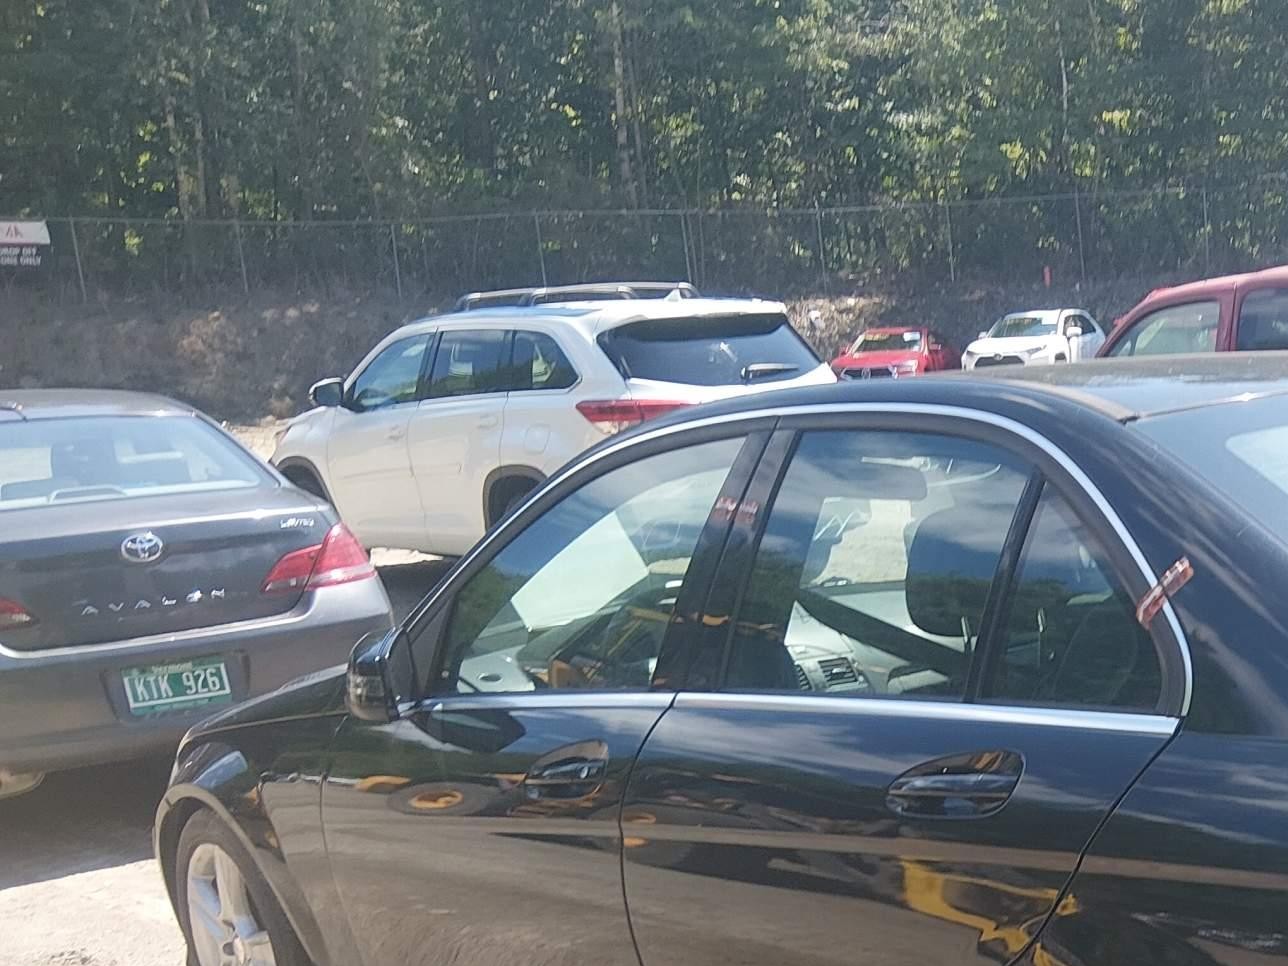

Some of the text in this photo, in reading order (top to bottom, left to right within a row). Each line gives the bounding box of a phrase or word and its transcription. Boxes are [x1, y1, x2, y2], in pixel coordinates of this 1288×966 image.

[81, 587, 225, 616] AVALON
[134, 667, 221, 702] KTK 926
